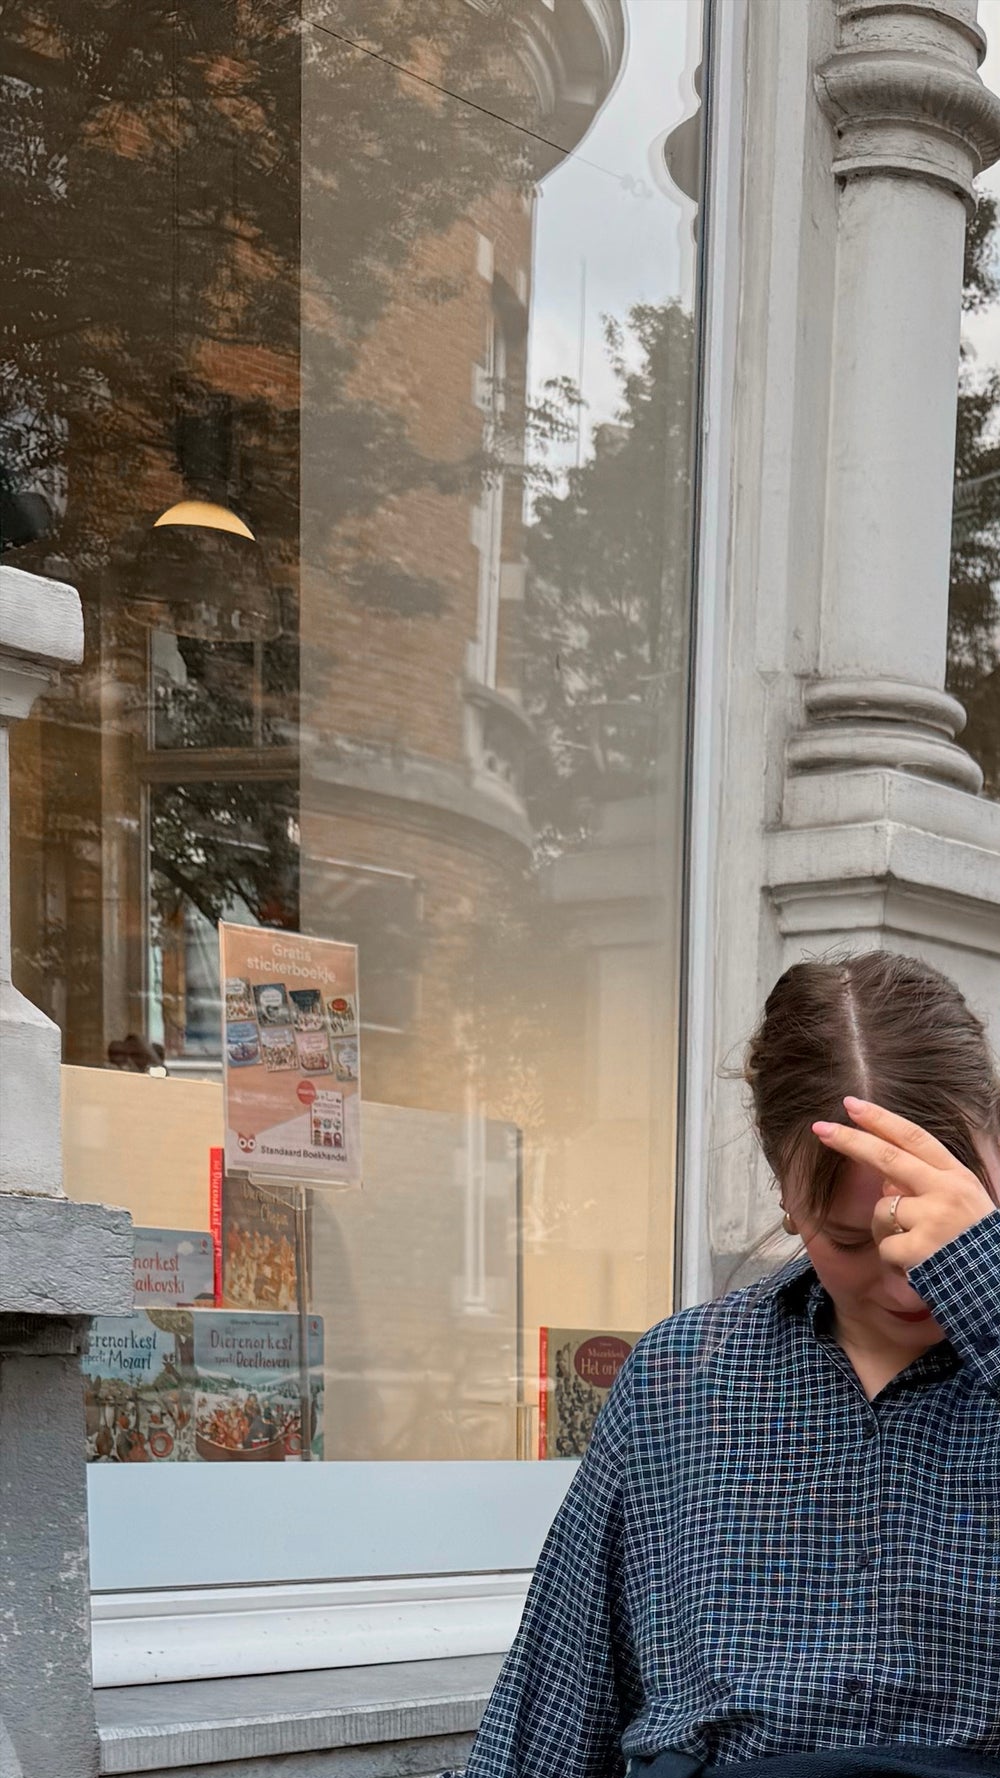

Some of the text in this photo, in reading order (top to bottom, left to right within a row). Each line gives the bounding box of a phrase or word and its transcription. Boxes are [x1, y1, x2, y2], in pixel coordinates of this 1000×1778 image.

[271, 943, 312, 962] Gratis
[247, 956, 336, 984] stickerboekje
[261, 1145, 347, 1162] Standaard Boekhandel
[133, 1252, 180, 1272] norkest
[135, 1274, 185, 1294] aikovski
[210, 1329, 293, 1351] Dierenorkest
[108, 1350, 152, 1370] Mozart
[581, 1358, 600, 1375] Het
